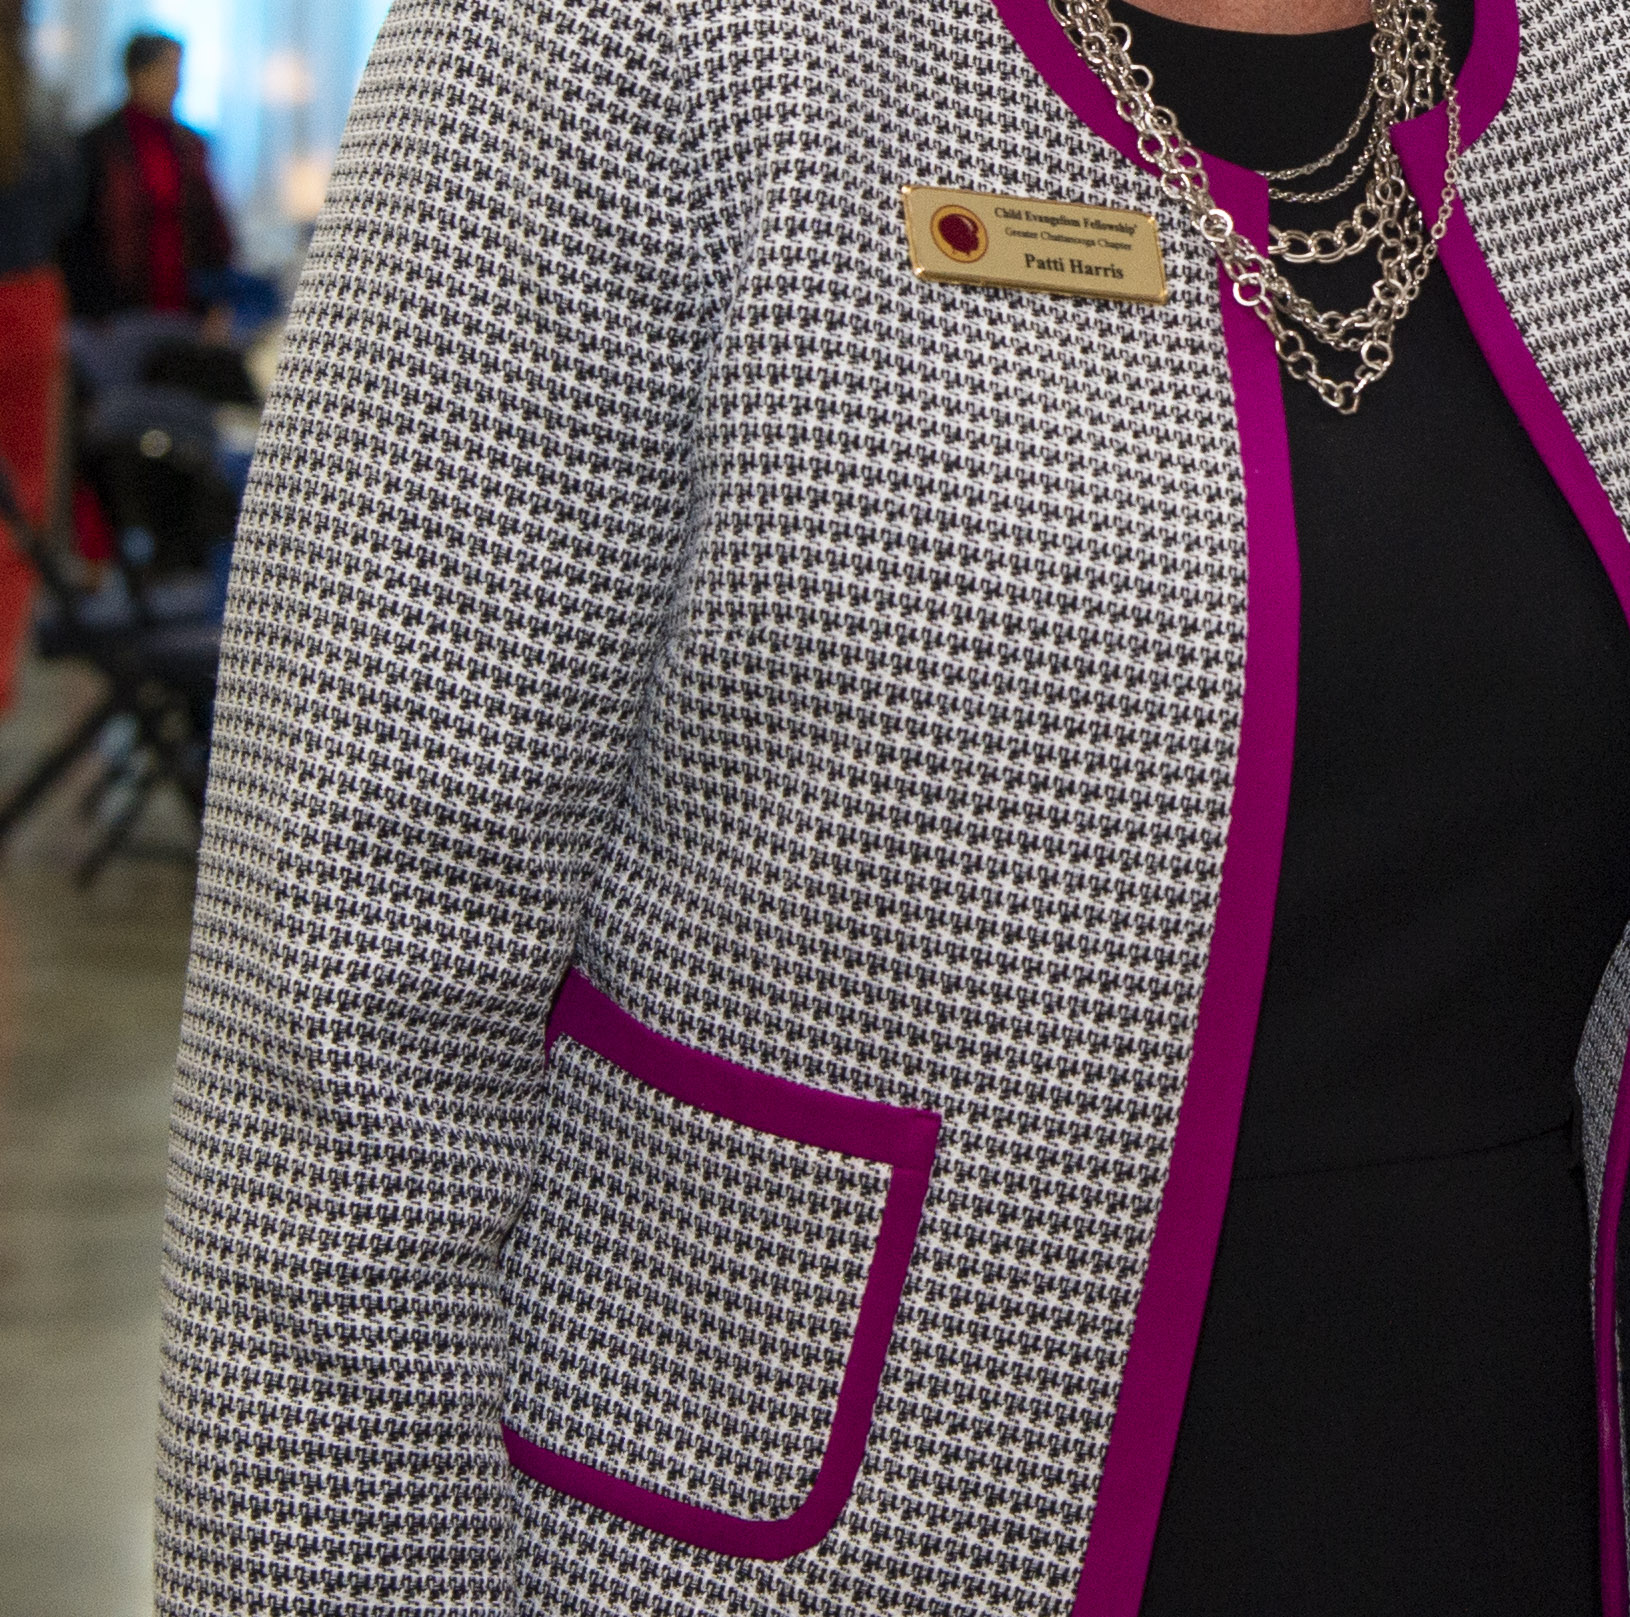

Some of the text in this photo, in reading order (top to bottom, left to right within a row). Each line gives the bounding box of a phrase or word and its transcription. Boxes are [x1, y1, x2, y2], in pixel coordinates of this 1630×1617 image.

[994, 207, 1022, 220] Child
[1025, 210, 1080, 226] Evangelism
[1005, 227, 1038, 238] Greater
[1025, 253, 1123, 279] Patti Harris
